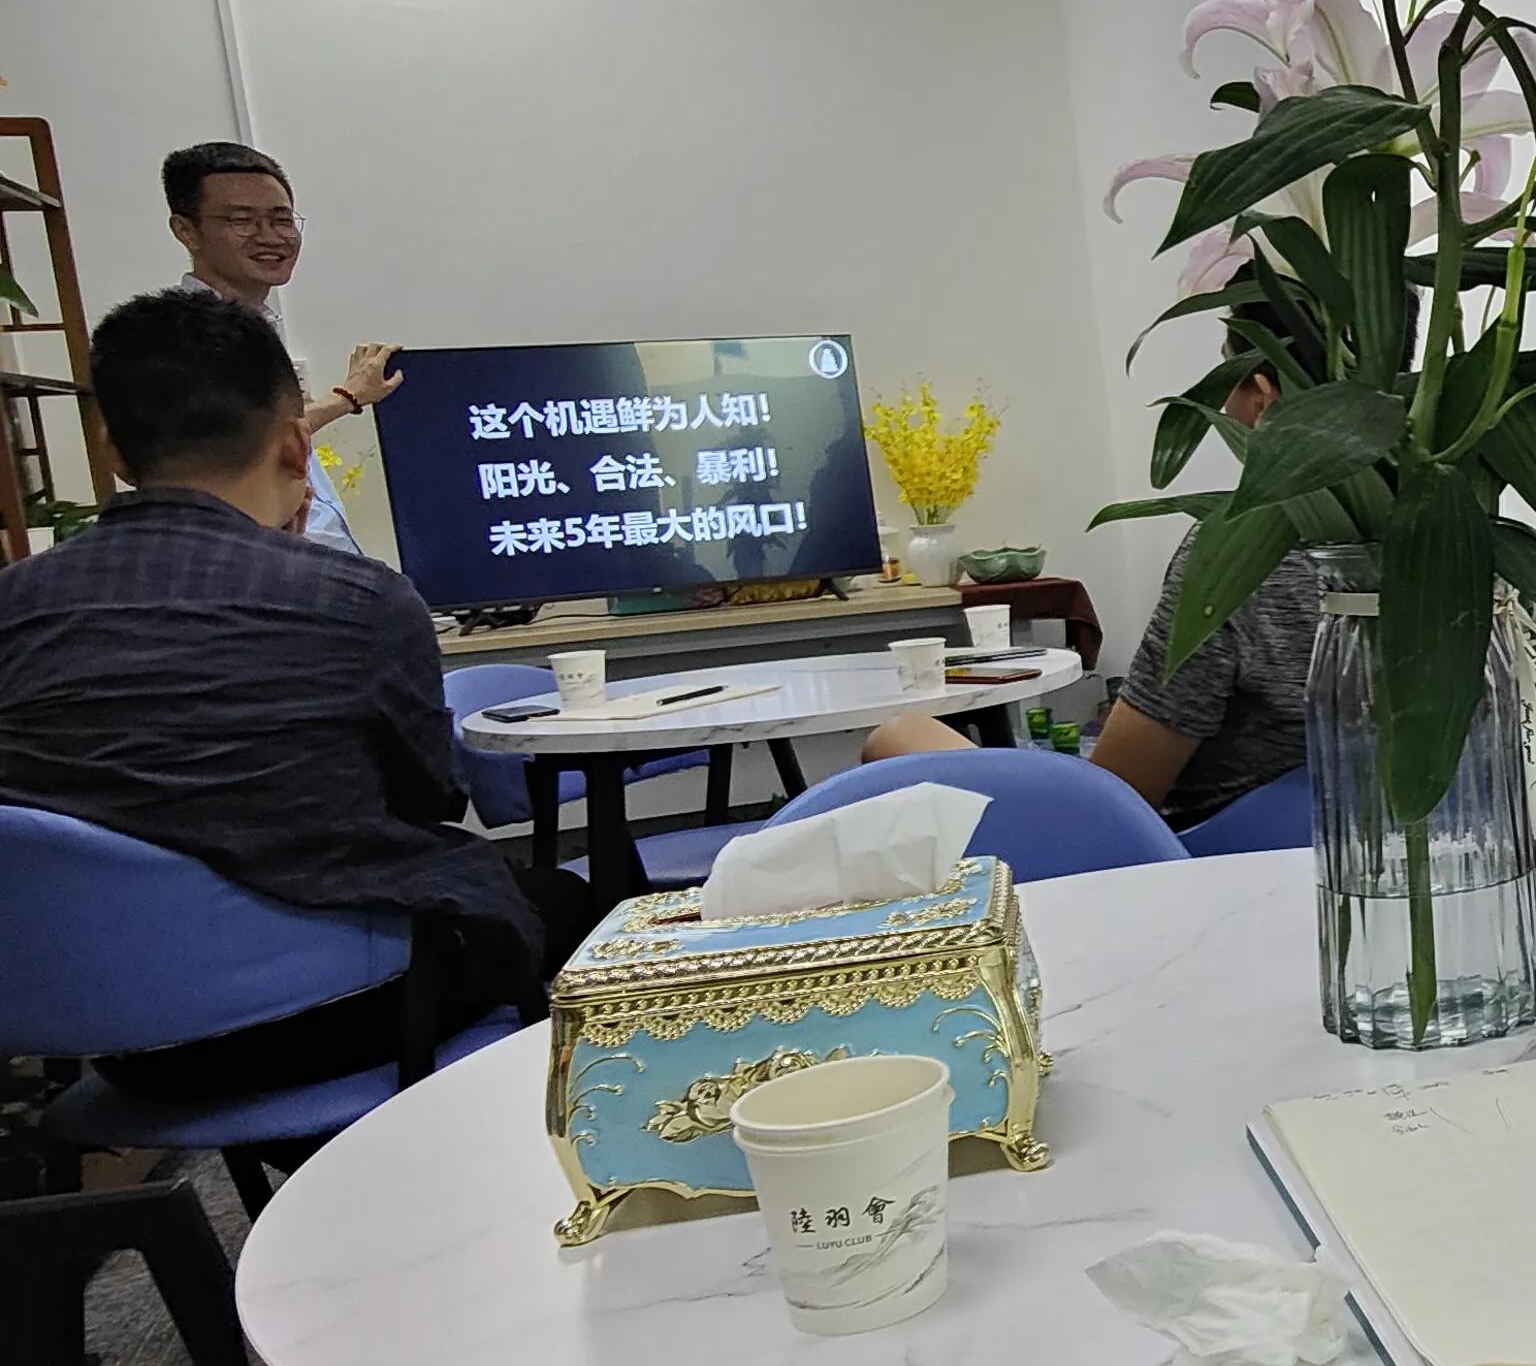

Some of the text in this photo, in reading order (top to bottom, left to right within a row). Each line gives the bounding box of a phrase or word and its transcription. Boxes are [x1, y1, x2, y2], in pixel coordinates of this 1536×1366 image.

[468, 392, 771, 440] 这个机遇鲜为人知!
[489, 501, 808, 557] 未来5年最大的风口!
[816, 1234, 873, 1250] LUYU CLUB
